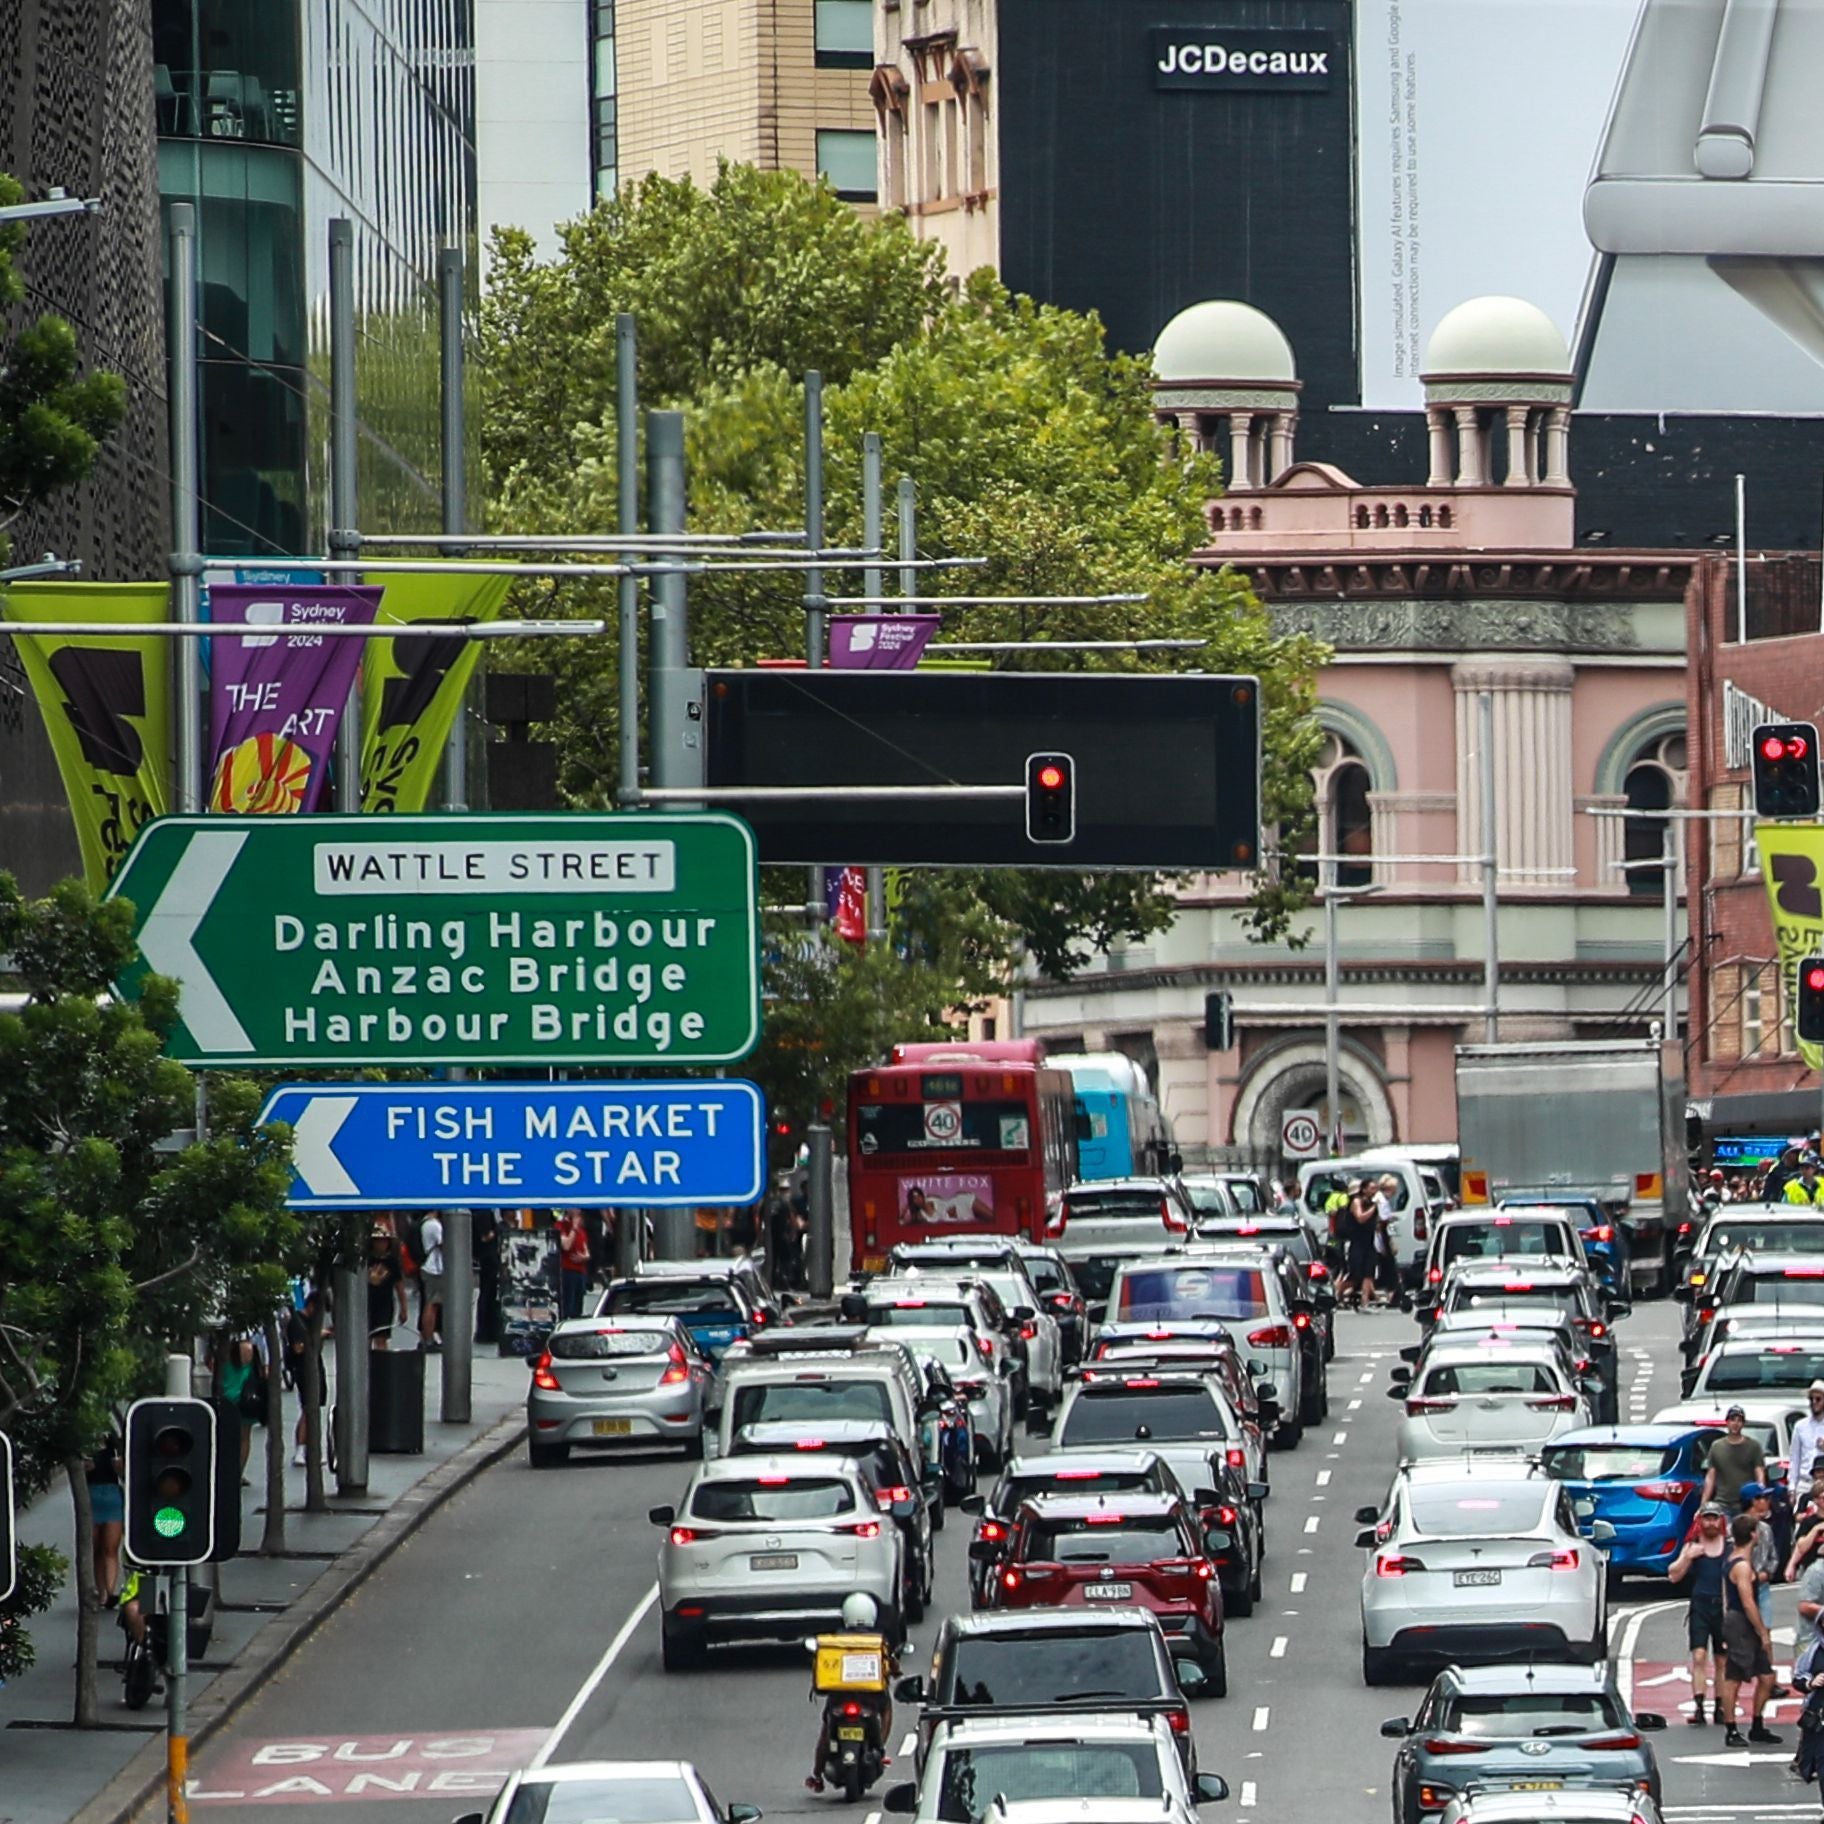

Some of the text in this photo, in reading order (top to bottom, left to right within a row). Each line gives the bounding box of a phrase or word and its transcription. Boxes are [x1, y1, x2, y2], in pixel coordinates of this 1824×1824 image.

[1387, 4, 1401, 45] Google
[1157, 45, 1329, 75] JCDecaux
[1388, 47, 1399, 69] and
[1388, 71, 1401, 124] Samsung
[1390, 126, 1402, 173] requires
[1406, 135, 1416, 156] use
[1406, 158, 1417, 171] to
[1390, 176, 1402, 222] features
[1406, 173, 1419, 221] required
[1407, 223, 1418, 238] be
[1391, 241, 1405, 277] Galaxy
[1408, 241, 1421, 264] may
[1407, 266, 1419, 330] connection
[1408, 332, 1419, 378] Internet
[290, 602, 346, 620] Sydney
[287, 634, 324, 647] 2024
[879, 631, 915, 642] Festival
[880, 622, 916, 635] Sydney
[225, 682, 283, 713] THE
[279, 708, 336, 739] ART
[327, 852, 663, 882] WATTLE STREET
[274, 911, 717, 961] Darling Harbour
[310, 956, 688, 1003] Anzac Bridge
[284, 1004, 706, 1052] Harbour Bridge
[387, 1103, 725, 1140] FISH MARKET
[930, 1113, 955, 1132] 40
[1289, 1125, 1313, 1143] 40
[432, 1150, 682, 1187] THE STAR
[900, 1176, 989, 1191] WHITE FOX
[250, 1737, 496, 1766] BUS
[184, 1770, 512, 1800] LANE
